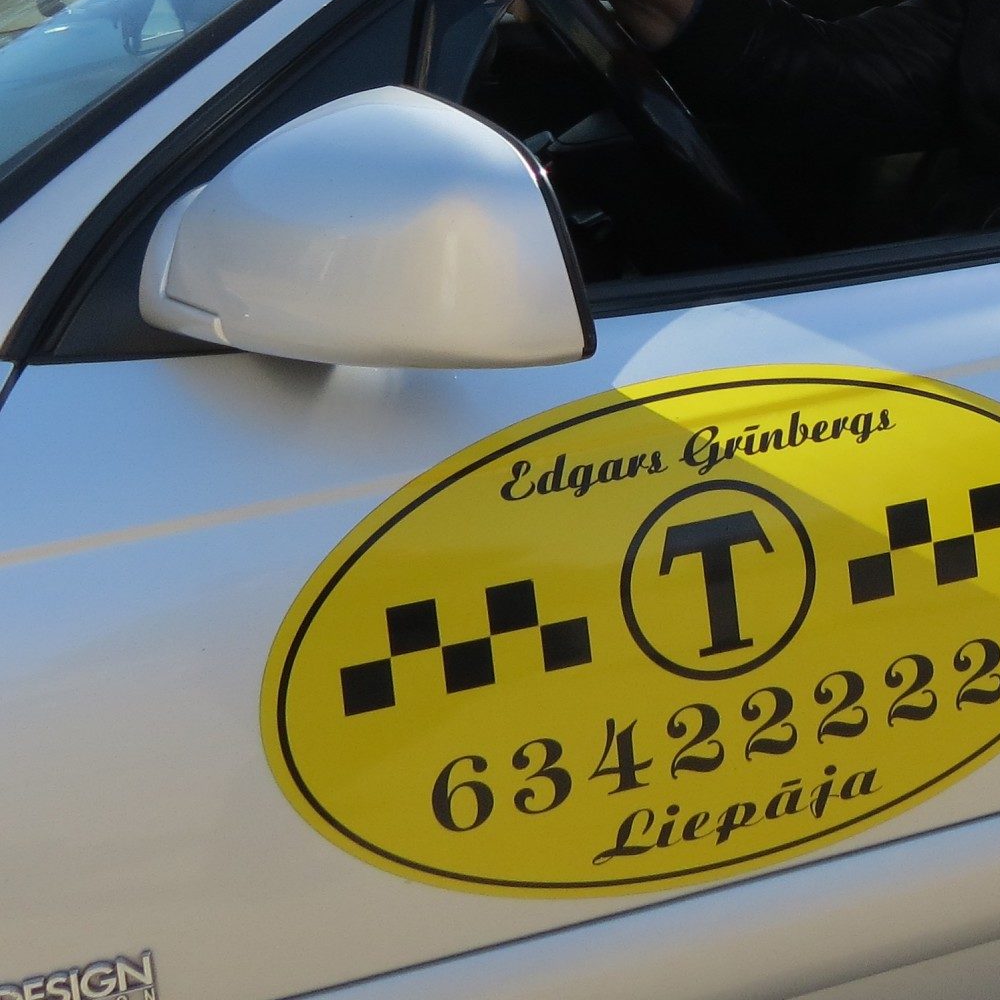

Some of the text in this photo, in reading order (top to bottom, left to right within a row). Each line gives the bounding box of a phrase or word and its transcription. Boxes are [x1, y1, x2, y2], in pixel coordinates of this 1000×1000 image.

[499, 409, 898, 501] Edgars Grīnbergs
[659, 509, 776, 658] T
[592, 764, 884, 867] Liepāja
